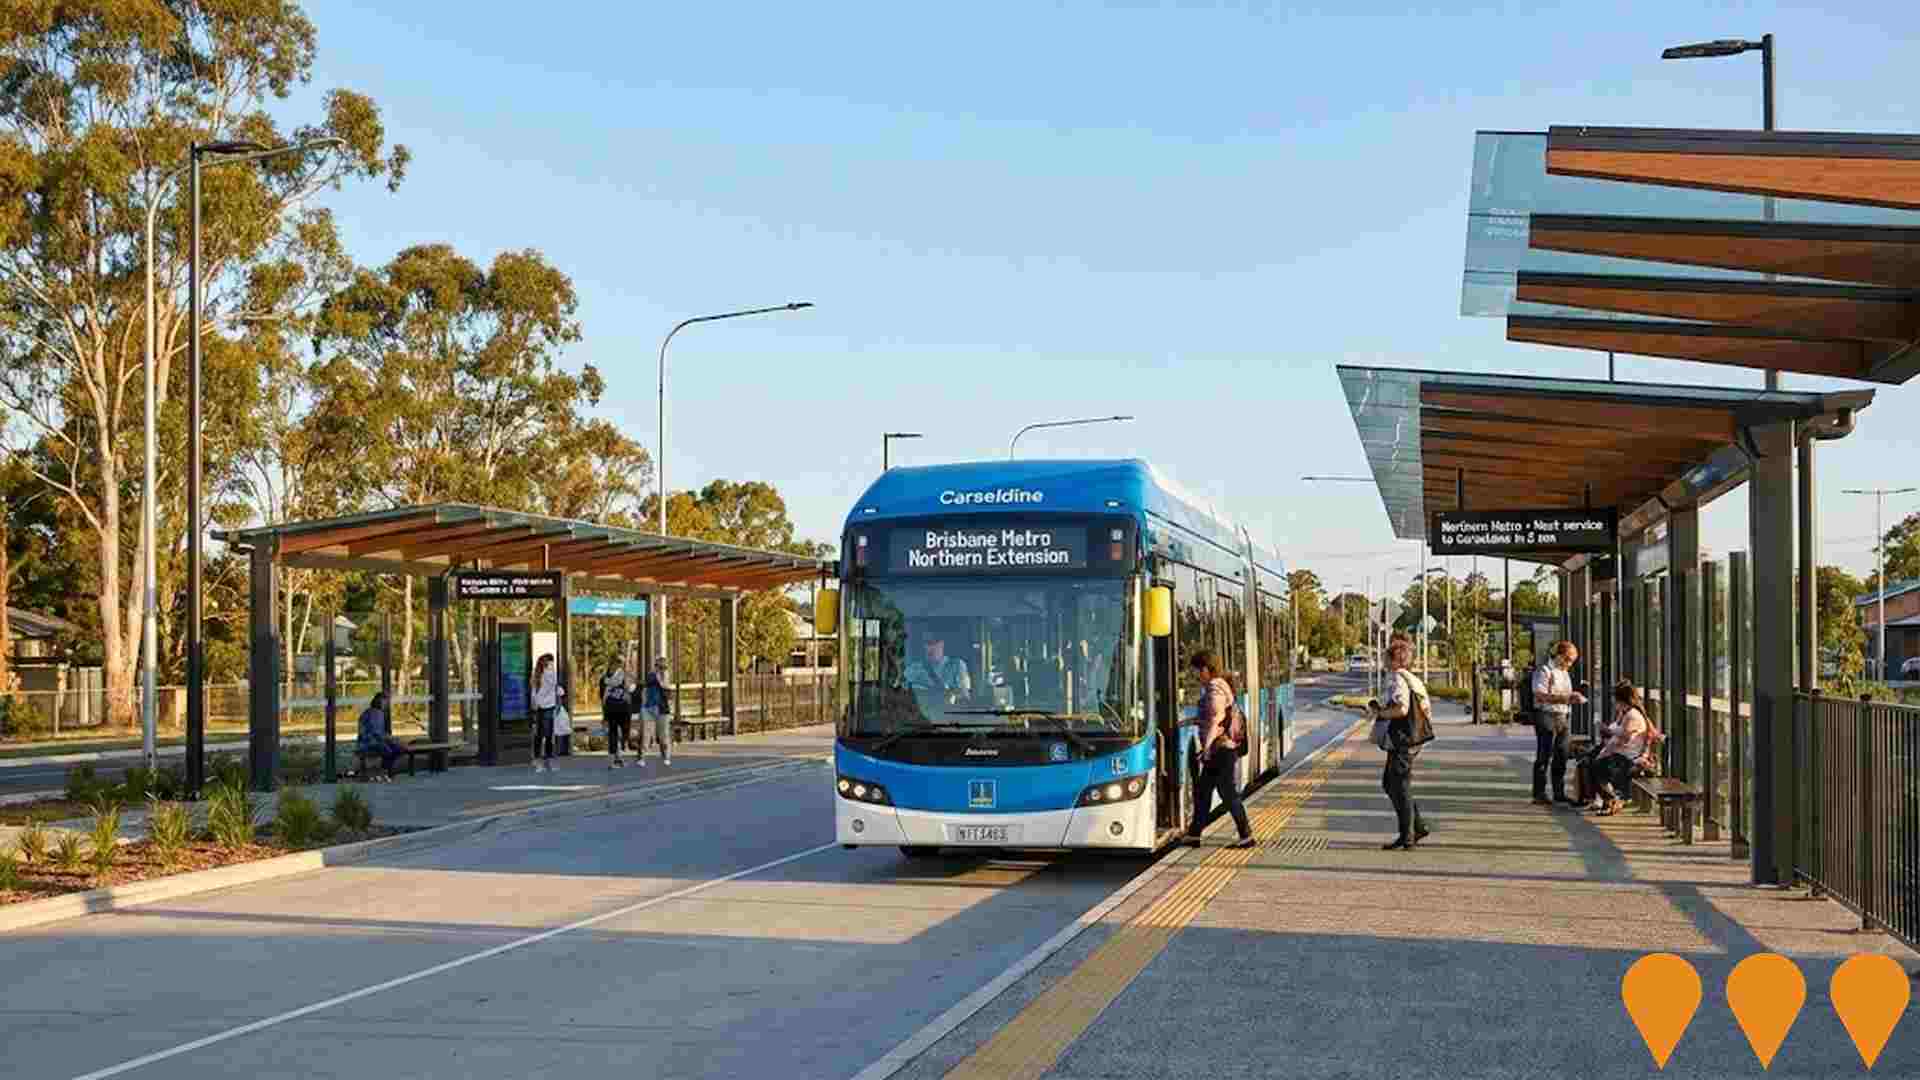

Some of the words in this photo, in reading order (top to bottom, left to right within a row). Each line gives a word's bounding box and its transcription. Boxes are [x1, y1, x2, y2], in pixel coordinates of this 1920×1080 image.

[939, 488, 1044, 505] Carseldine
[925, 530, 998, 548] Brisbane
[1001, 529, 1051, 547] Metro
[908, 549, 983, 567] Northern
[987, 548, 1070, 566] Extension
